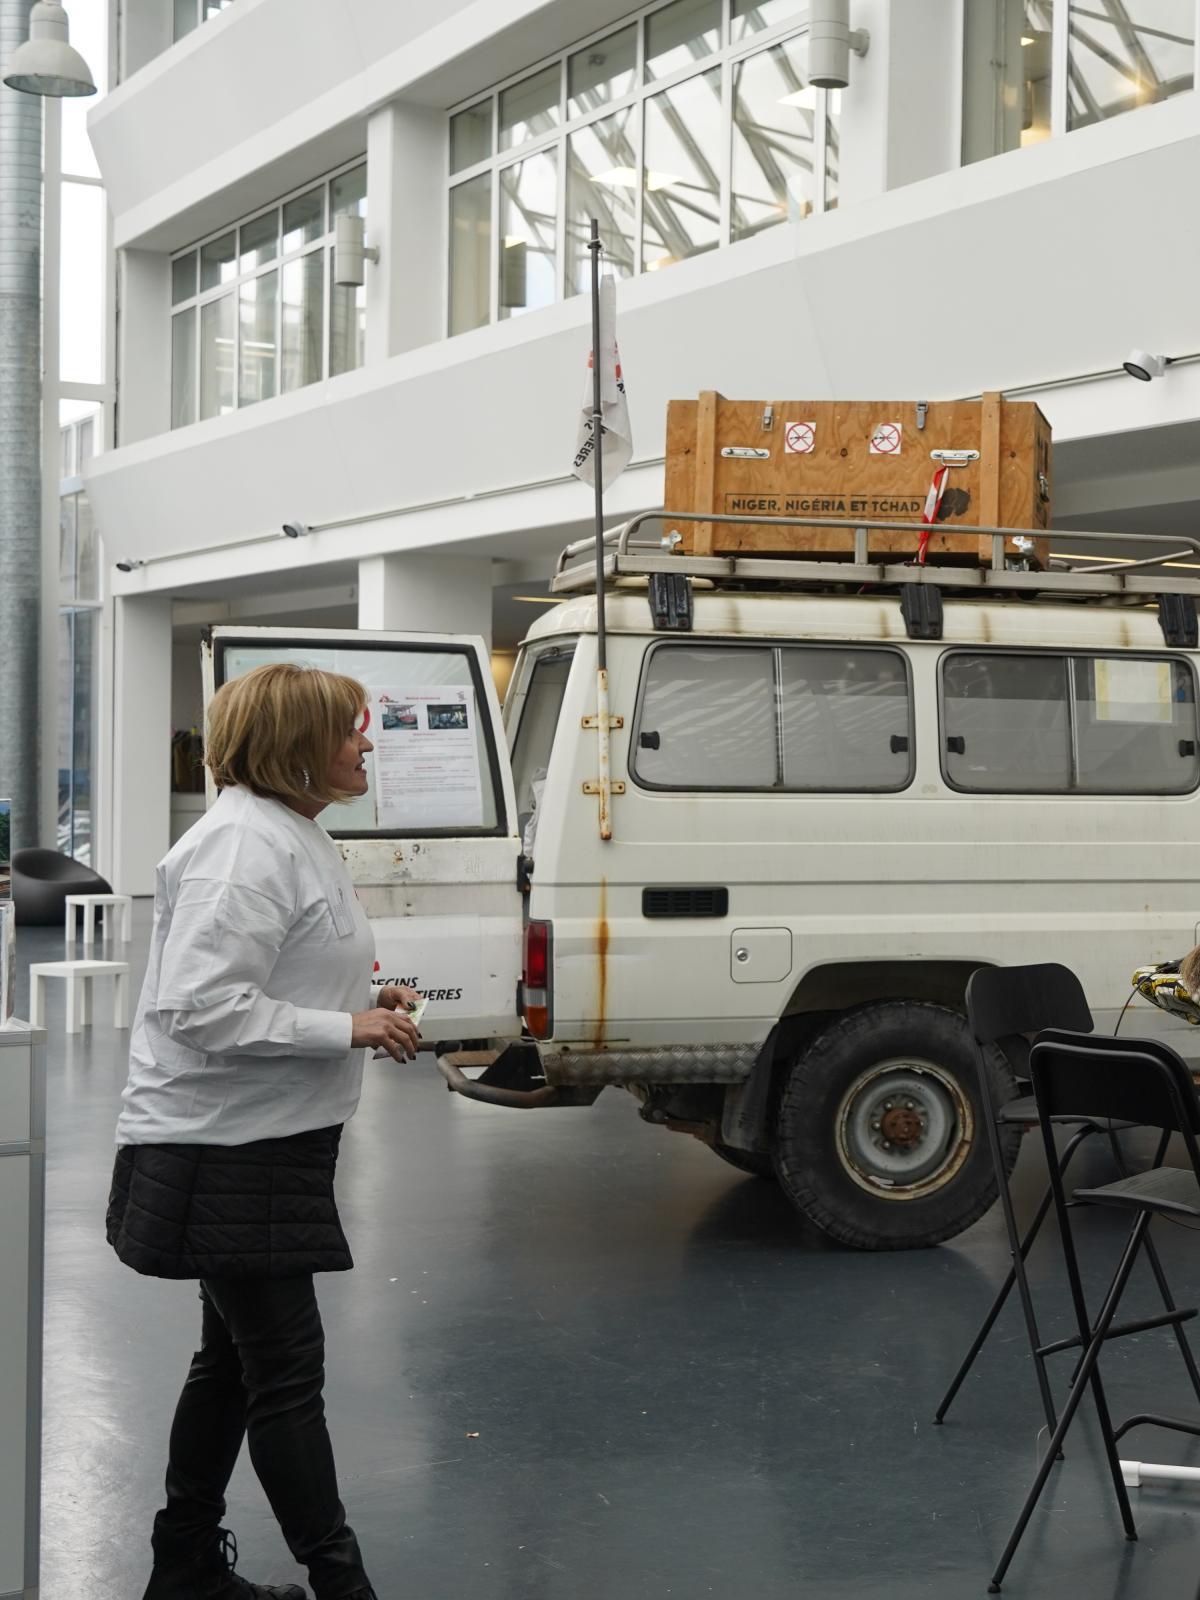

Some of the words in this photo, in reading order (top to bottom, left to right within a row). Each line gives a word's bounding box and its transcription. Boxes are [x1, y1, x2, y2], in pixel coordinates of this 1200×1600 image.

[732, 499, 781, 513] NIGER,
[785, 498, 846, 512] NIGÉRIA
[851, 500, 868, 512] ET
[872, 501, 921, 513] TCHAD
